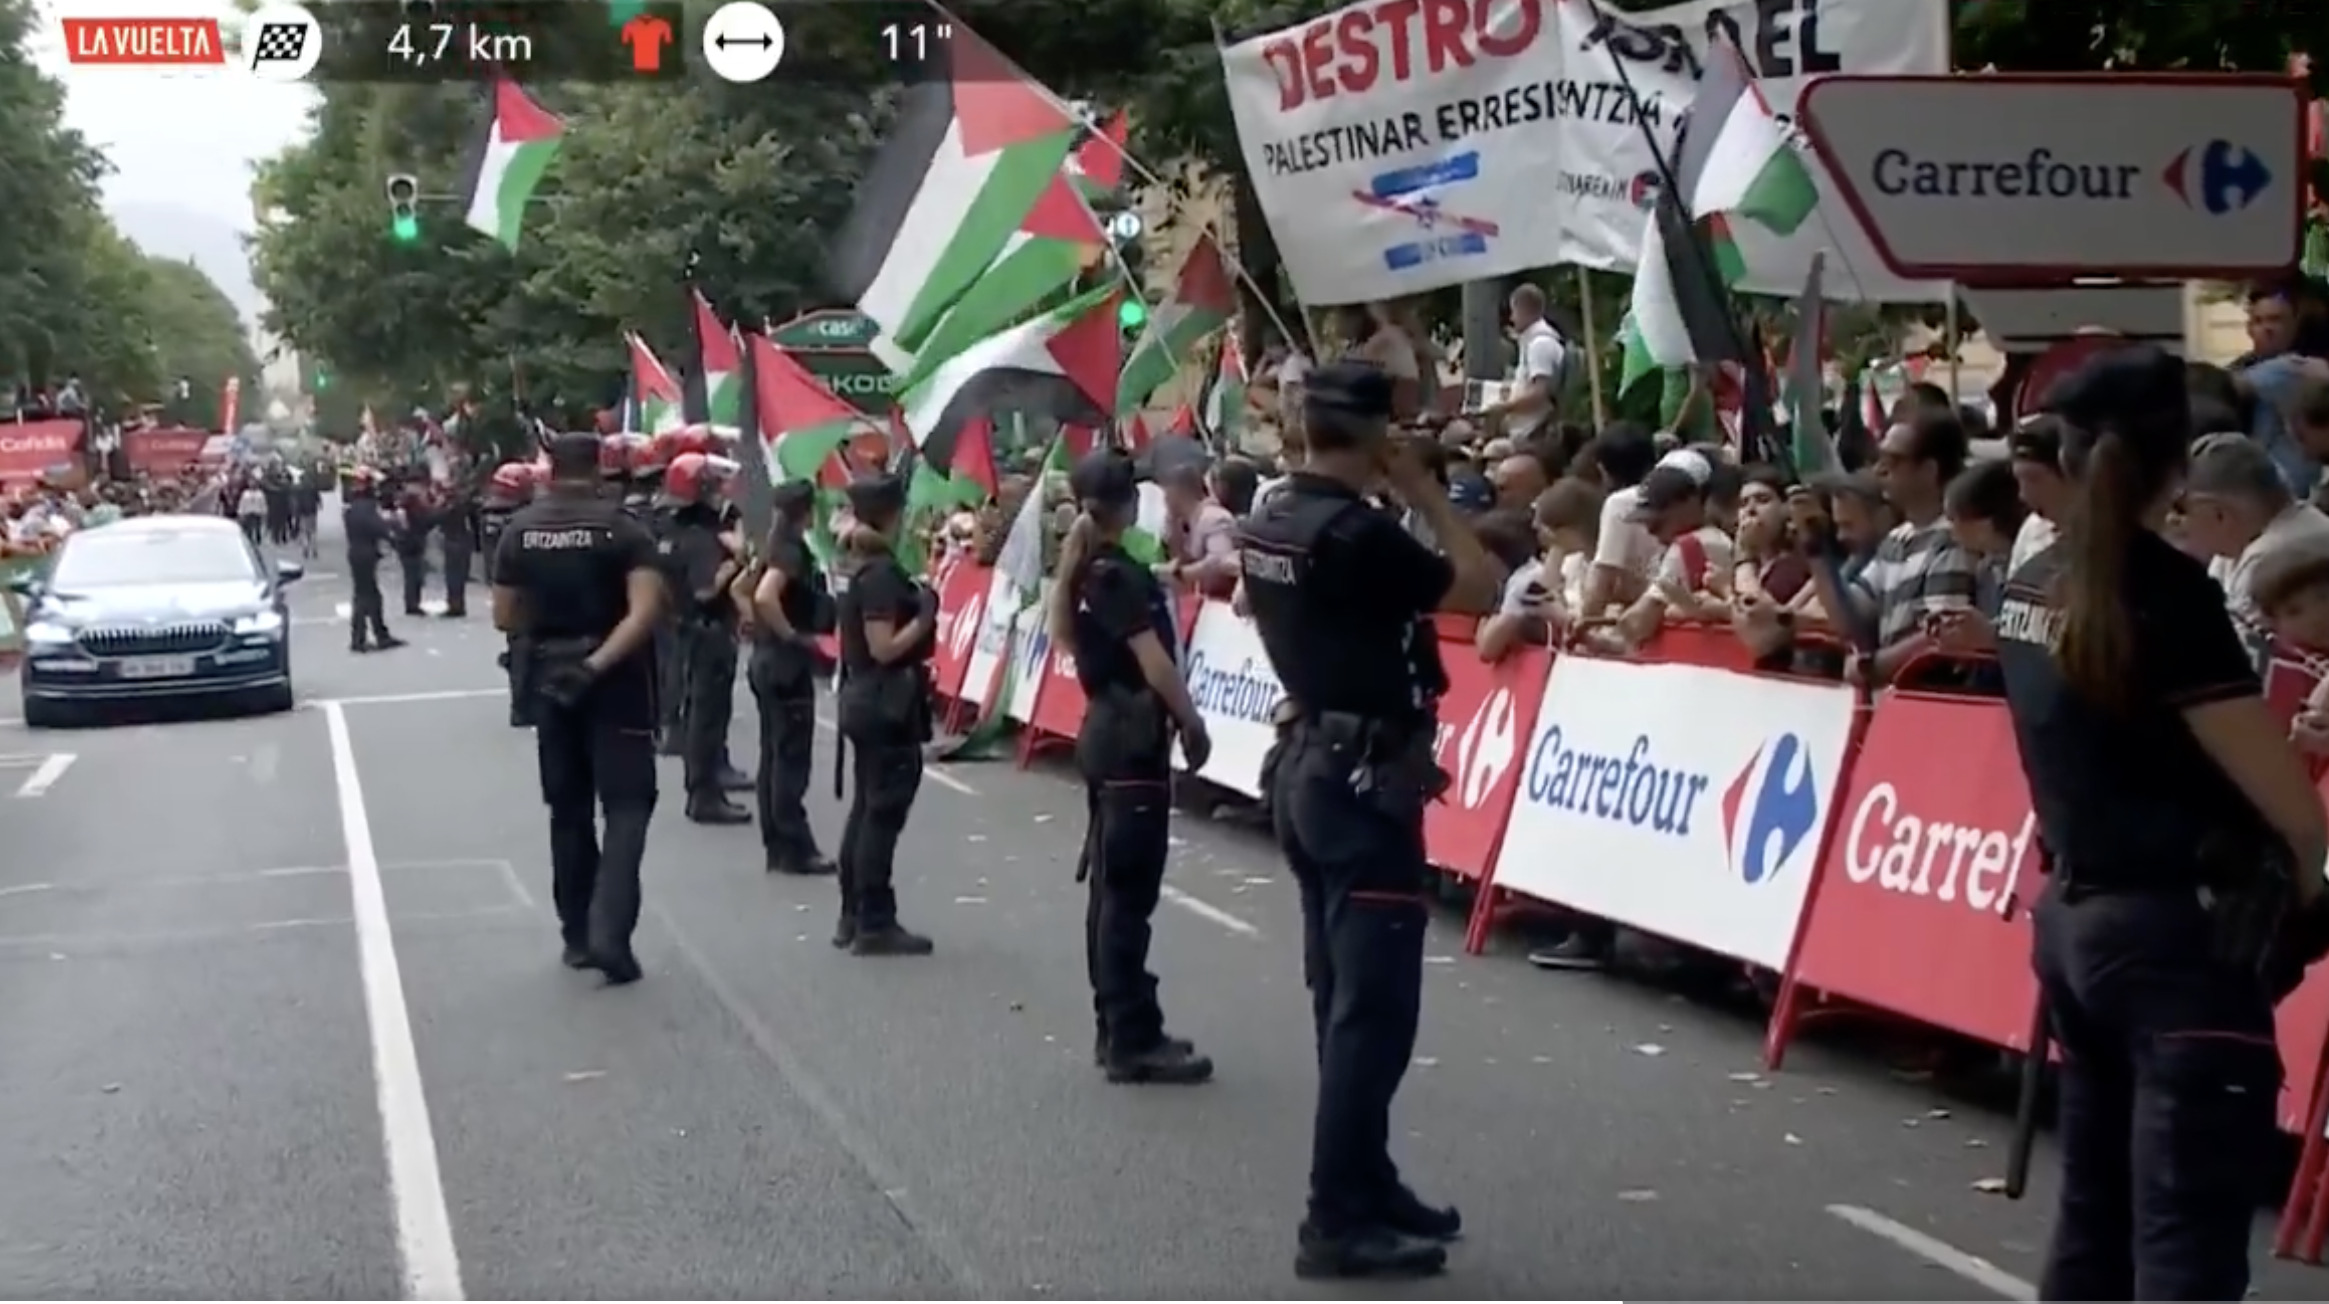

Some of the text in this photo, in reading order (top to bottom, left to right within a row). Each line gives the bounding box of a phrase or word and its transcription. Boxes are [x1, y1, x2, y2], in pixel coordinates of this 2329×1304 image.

[1263, 0, 1568, 112] DESTRO
[1264, 112, 1429, 176] PALESTINAR
[1872, 147, 2141, 200] Carrefour
[1182, 649, 1280, 724] Carrefour
[1528, 724, 1709, 836] Carrefour
